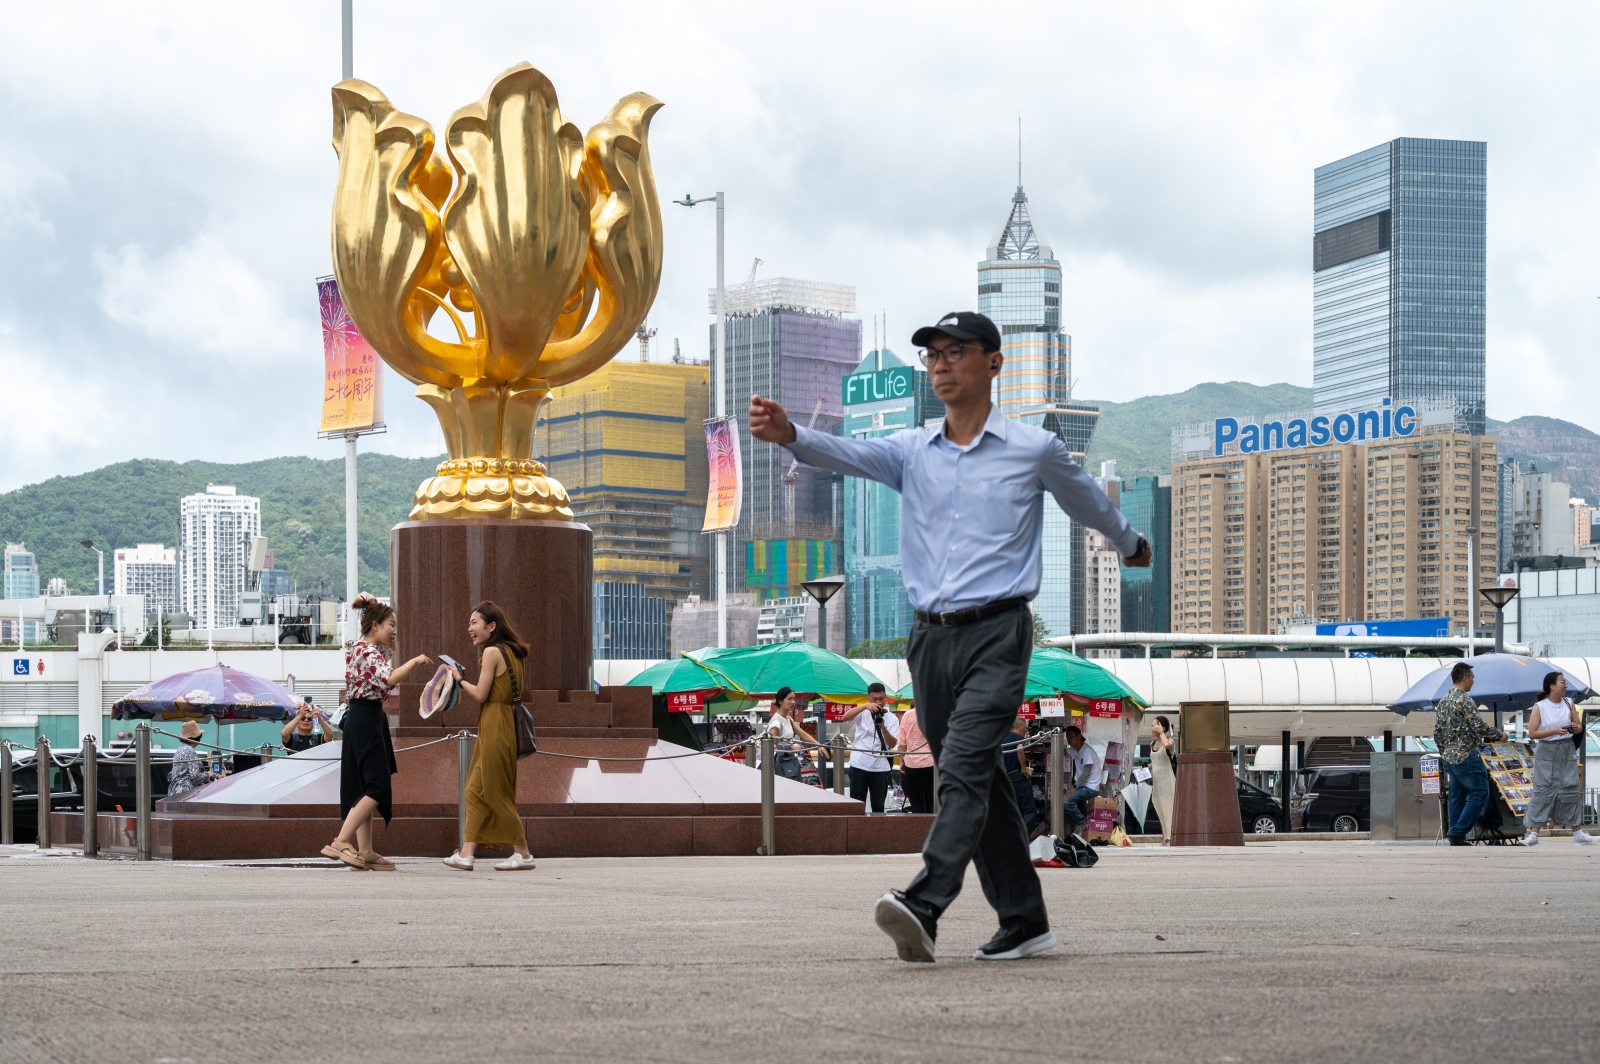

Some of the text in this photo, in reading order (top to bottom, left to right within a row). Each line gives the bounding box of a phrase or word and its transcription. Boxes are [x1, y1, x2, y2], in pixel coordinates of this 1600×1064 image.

[847, 370, 907, 403] FTLife
[1215, 398, 1416, 457] Panasonic
[673, 694, 698, 704] 6号档
[1095, 702, 1116, 712] 6号档
